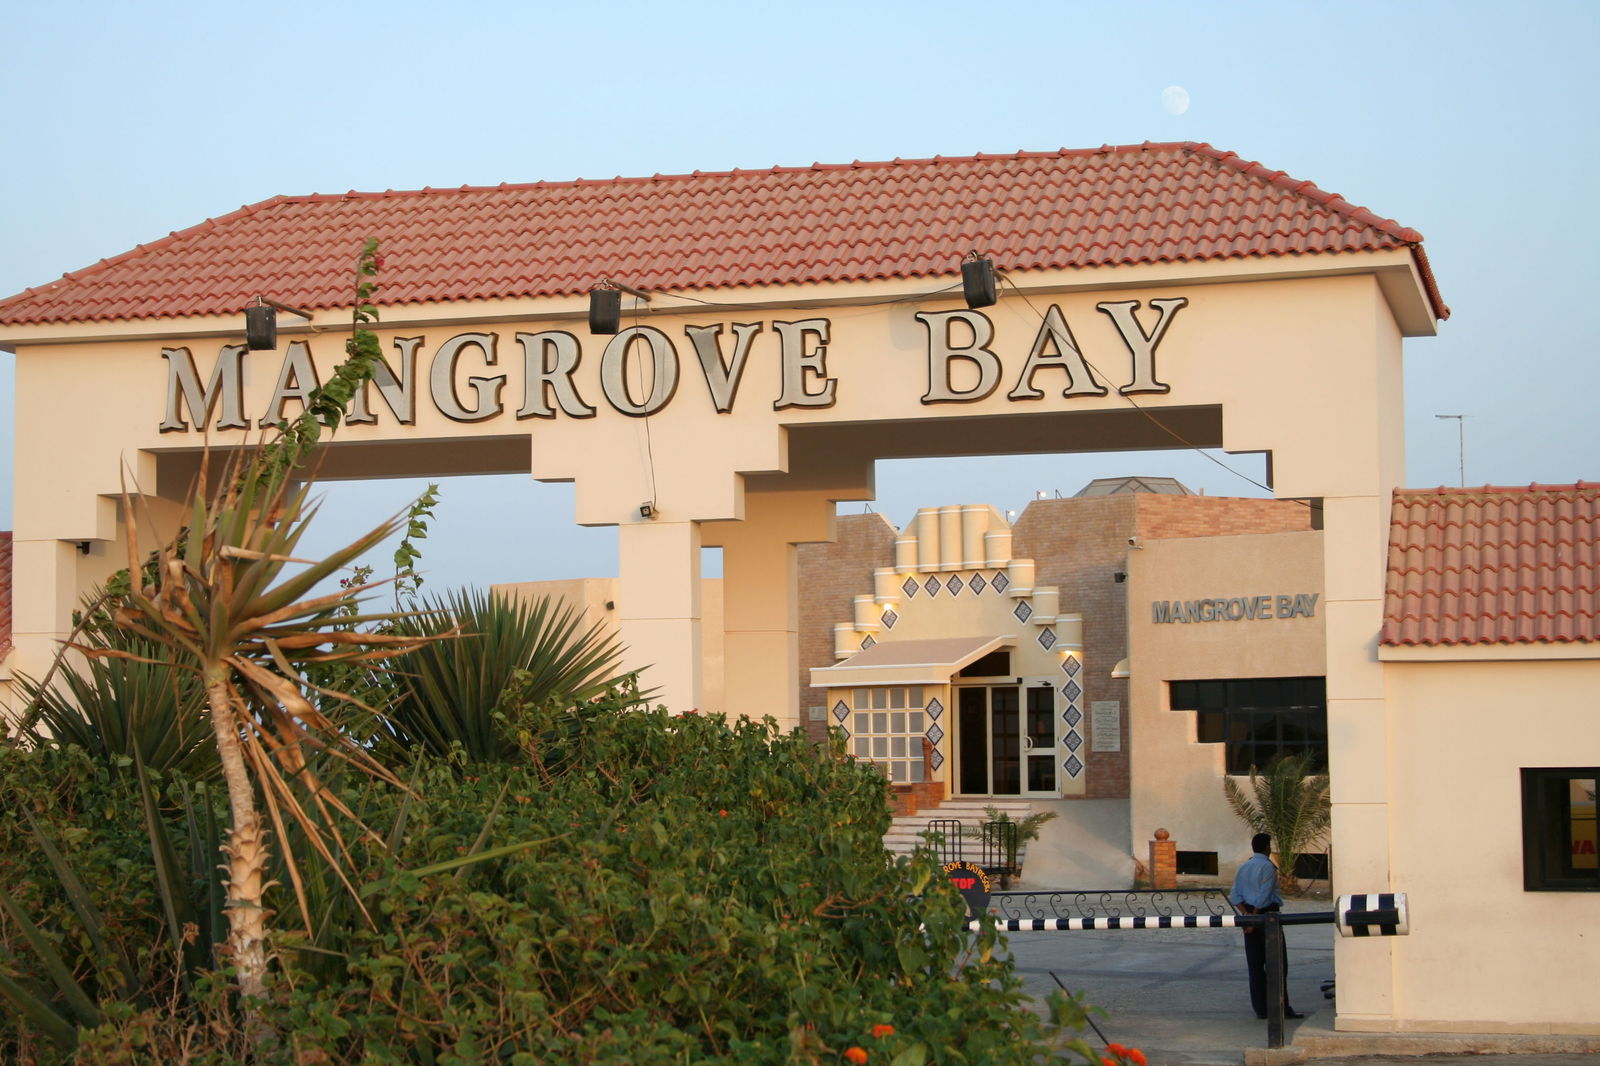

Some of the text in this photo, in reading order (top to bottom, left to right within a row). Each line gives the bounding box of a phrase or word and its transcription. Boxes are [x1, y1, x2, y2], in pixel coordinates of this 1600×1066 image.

[159, 297, 1189, 434] MANGROVE BAY
[1151, 592, 1320, 624] MANGROVE BAY
[949, 878, 976, 889] TOP
